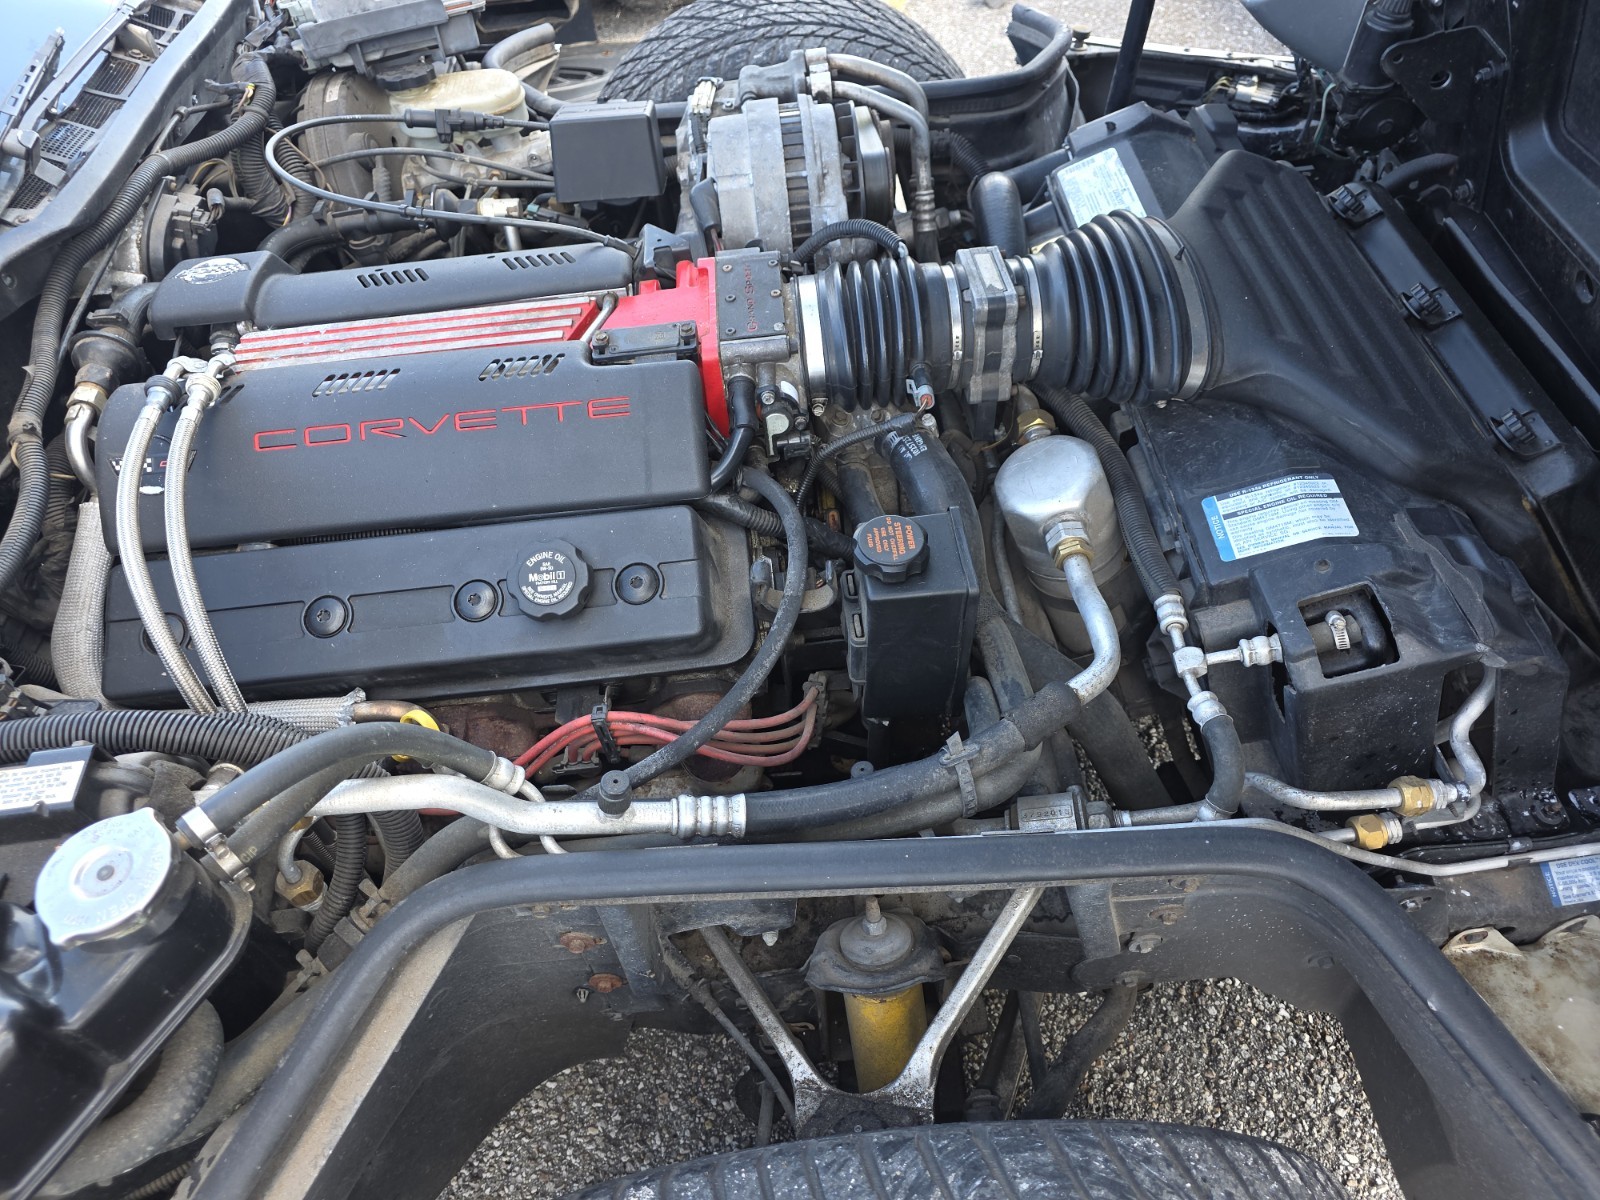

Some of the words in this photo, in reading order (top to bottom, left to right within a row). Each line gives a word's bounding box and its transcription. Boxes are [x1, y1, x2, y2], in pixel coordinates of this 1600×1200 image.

[253, 395, 633, 453] CORVETTE
[1263, 476, 1303, 489] REFRIGERANT
[1237, 505, 1262, 516] SPECIAL
[1263, 499, 1285, 509] ENGINE
[894, 522, 906, 554] STEERING
[905, 525, 916, 549] POWER
[1211, 515, 1225, 539] NOTICE
[526, 551, 553, 567] ENGINE
[554, 553, 566, 564] OIL
[529, 572, 555, 582] Mobil
[1545, 872, 1557, 897] NOTICE
